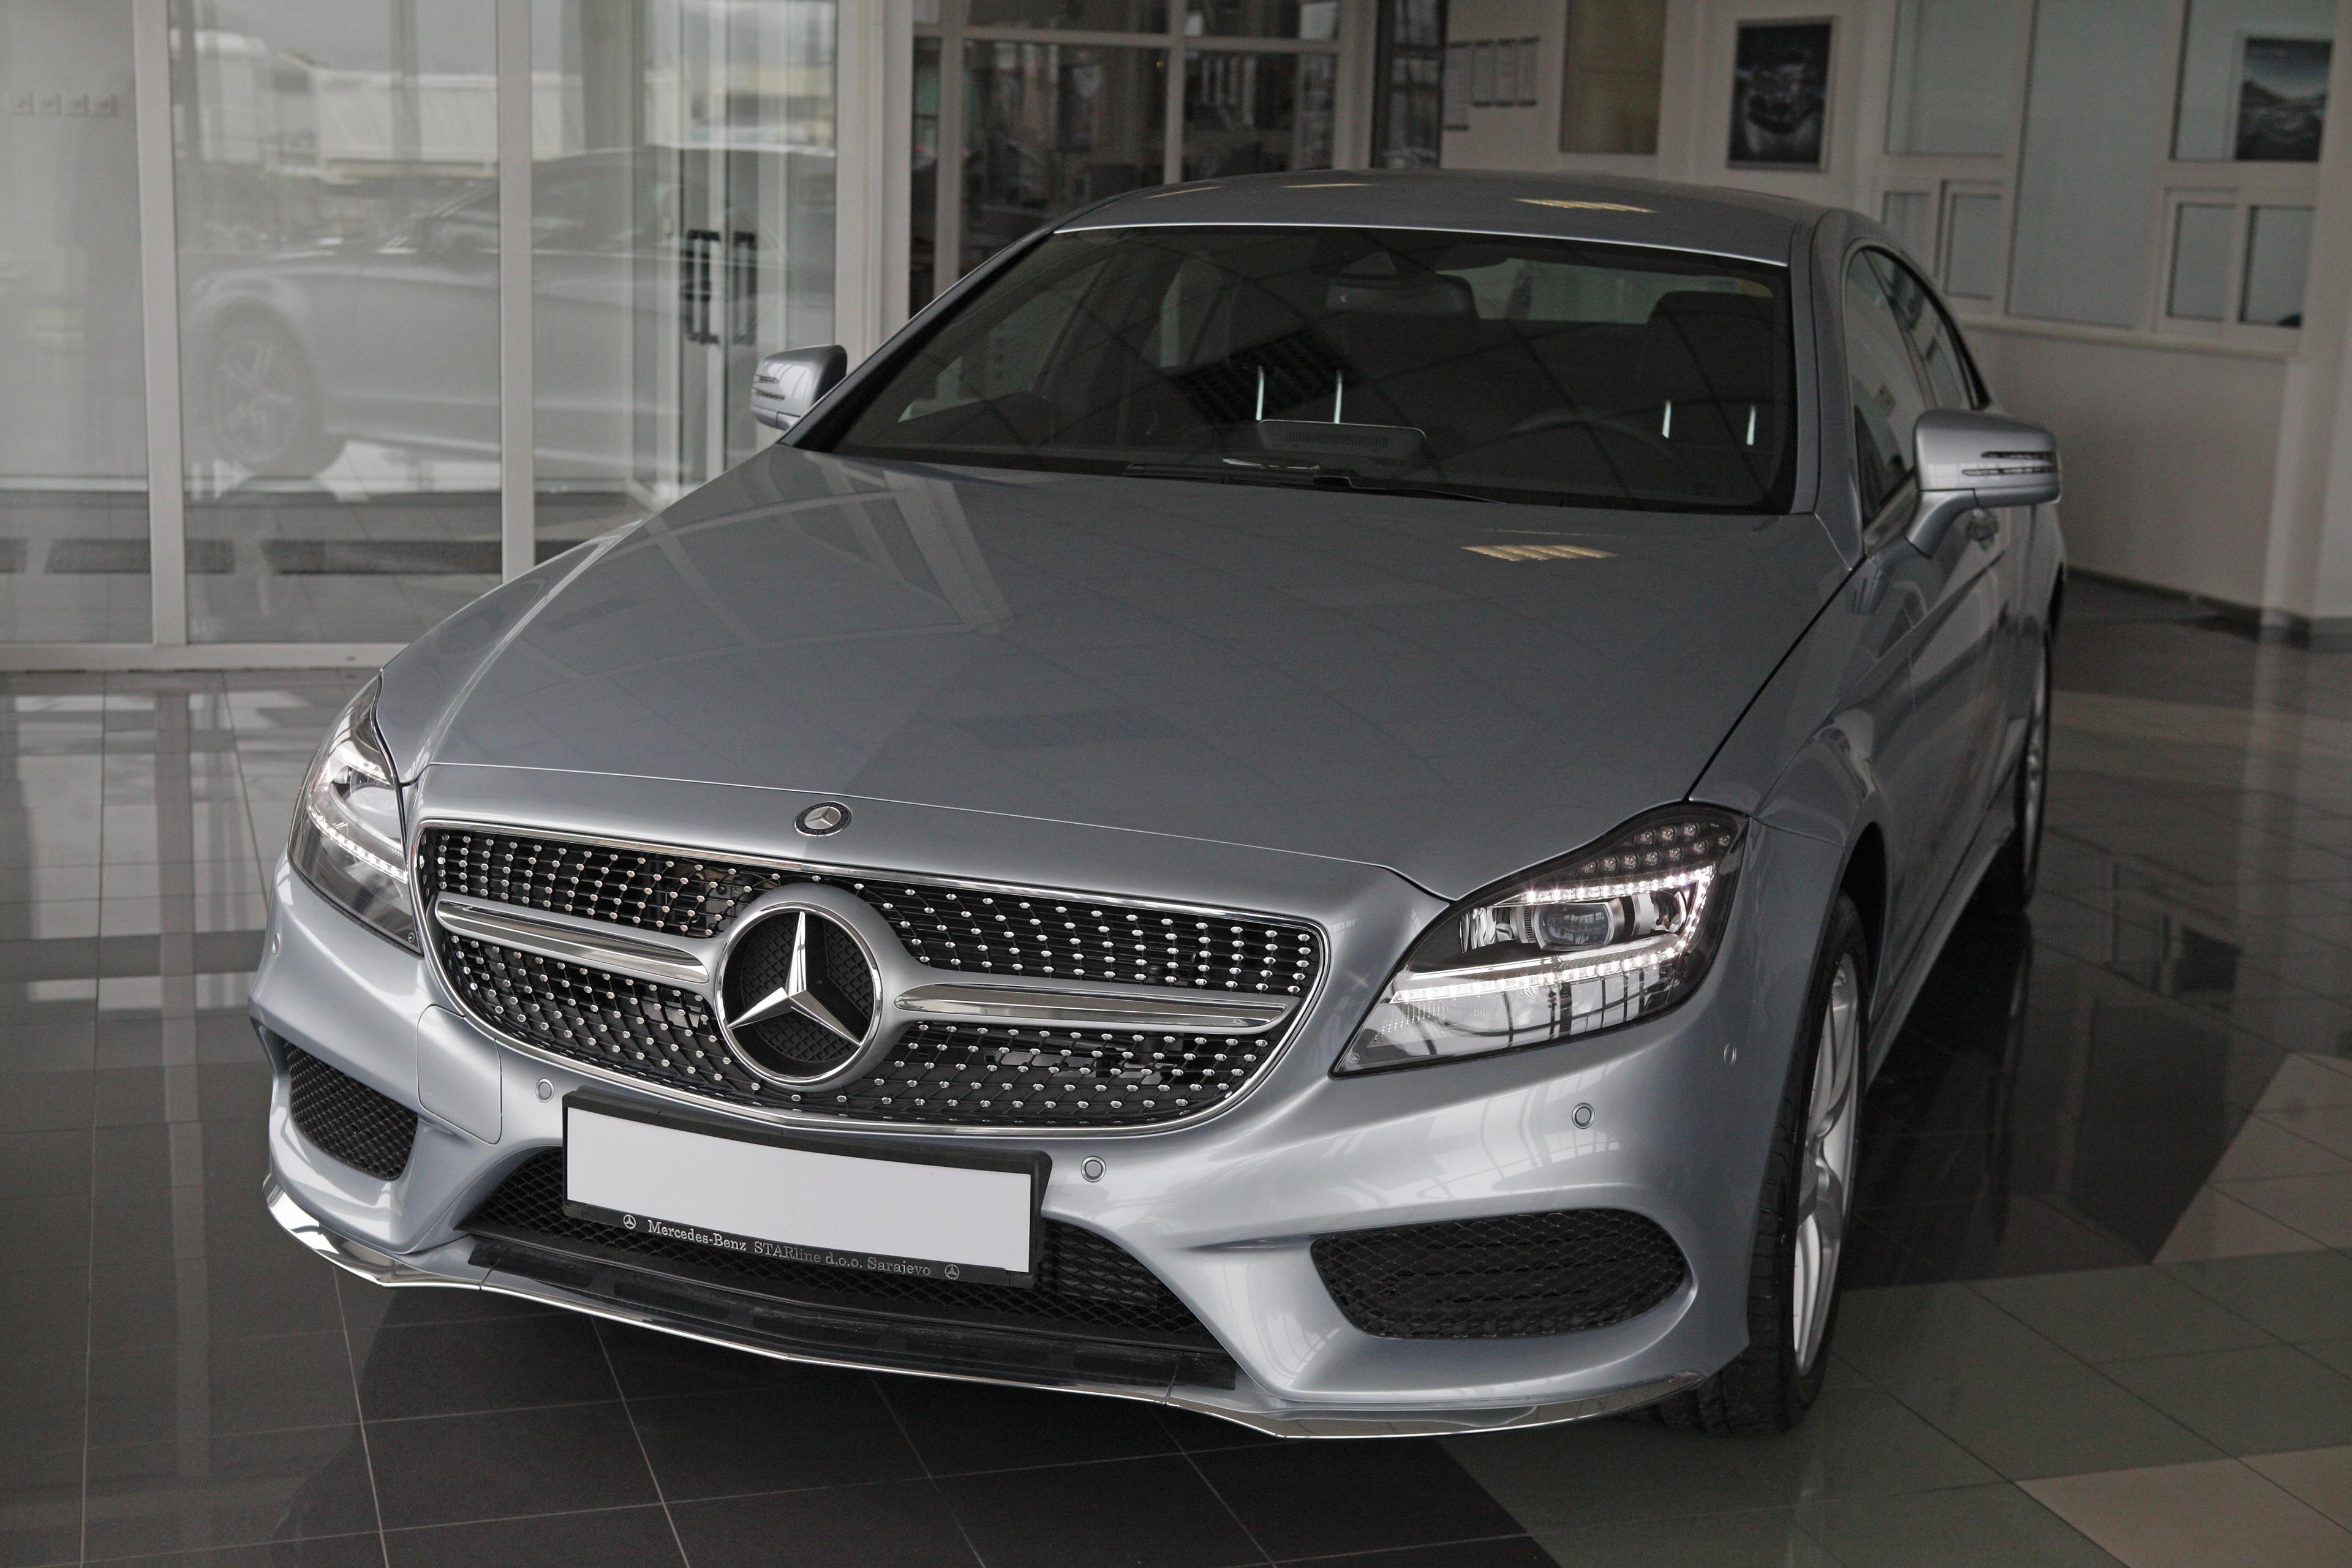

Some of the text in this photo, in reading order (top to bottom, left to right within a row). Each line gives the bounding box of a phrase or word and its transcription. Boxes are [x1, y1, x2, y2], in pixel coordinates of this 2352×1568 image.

[647, 1219, 931, 1276] Mercedes-Benz STARline d.o.o. Sarajevo
